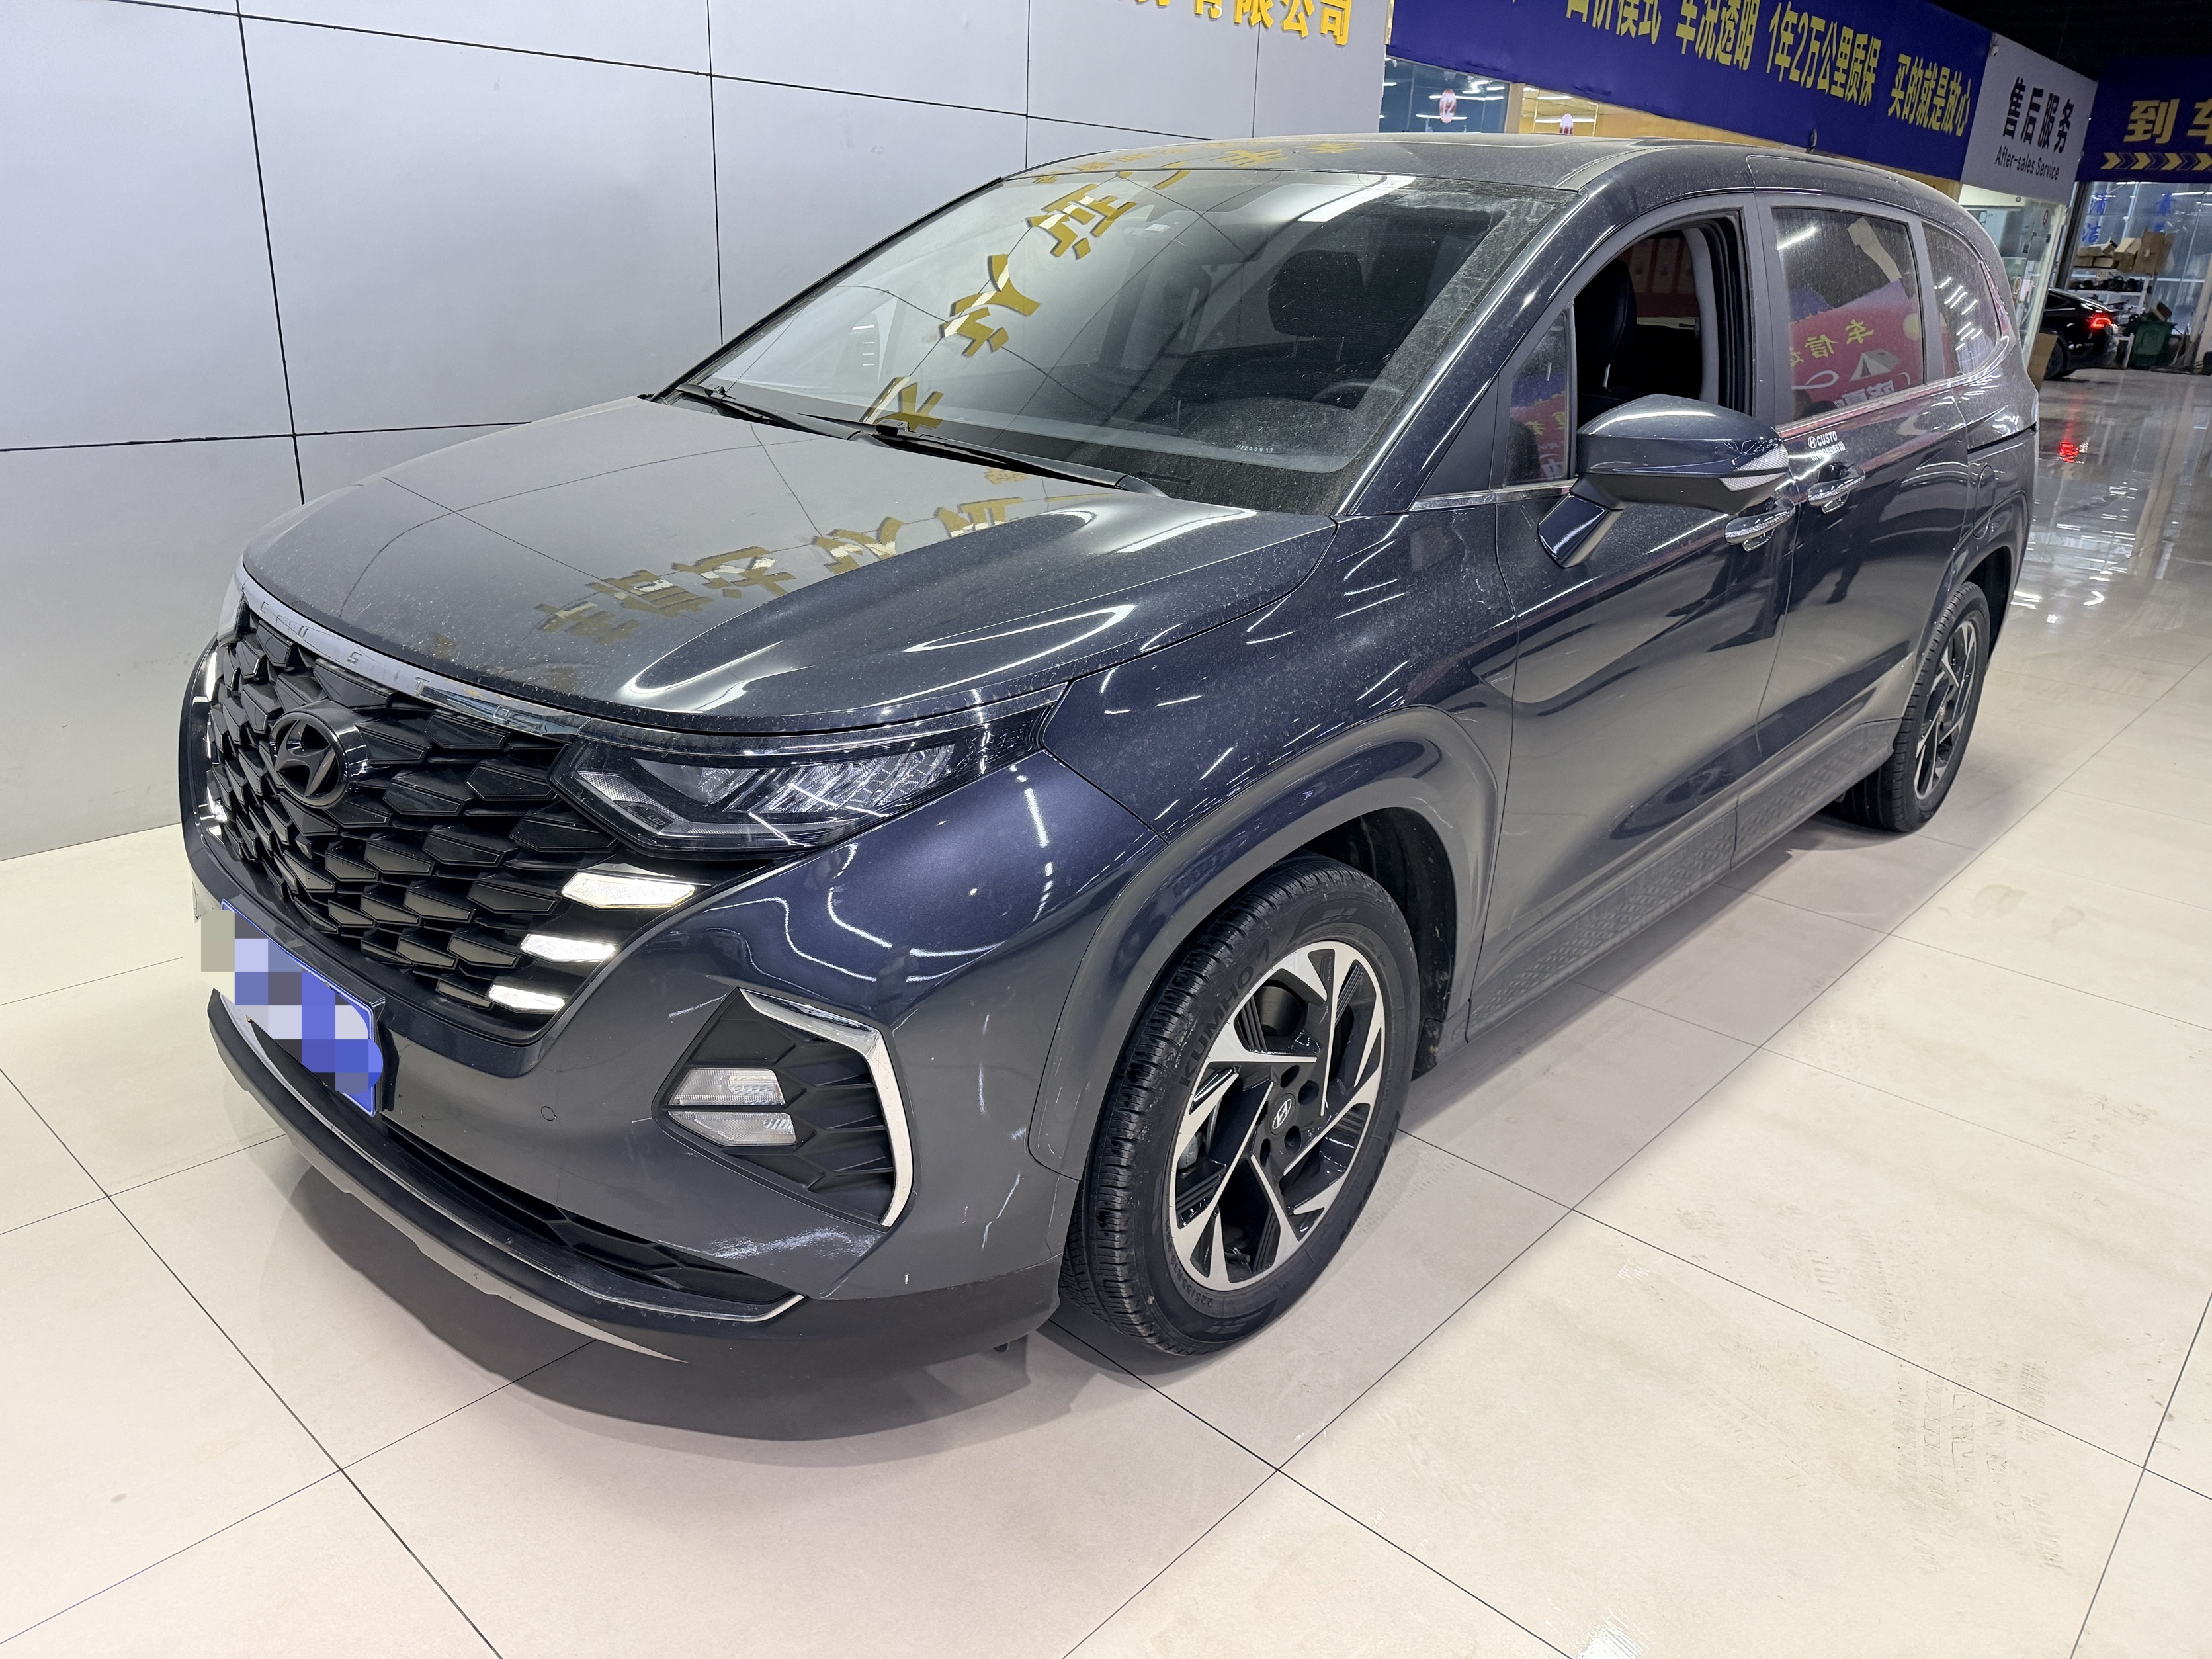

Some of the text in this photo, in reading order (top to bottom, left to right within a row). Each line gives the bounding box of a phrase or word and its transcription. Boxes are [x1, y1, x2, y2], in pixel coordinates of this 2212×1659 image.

[1676, 0, 1760, 71] 车况透明
[1766, 2, 1881, 106] 1年2万公里质保
[1888, 53, 1971, 136] 买的就是放心
[2003, 76, 2074, 153] 售后服务
[1995, 146, 2059, 181] After-sales Service
[1816, 430, 1838, 447] CUSTO
[1179, 966, 1254, 1087] KUMHO
